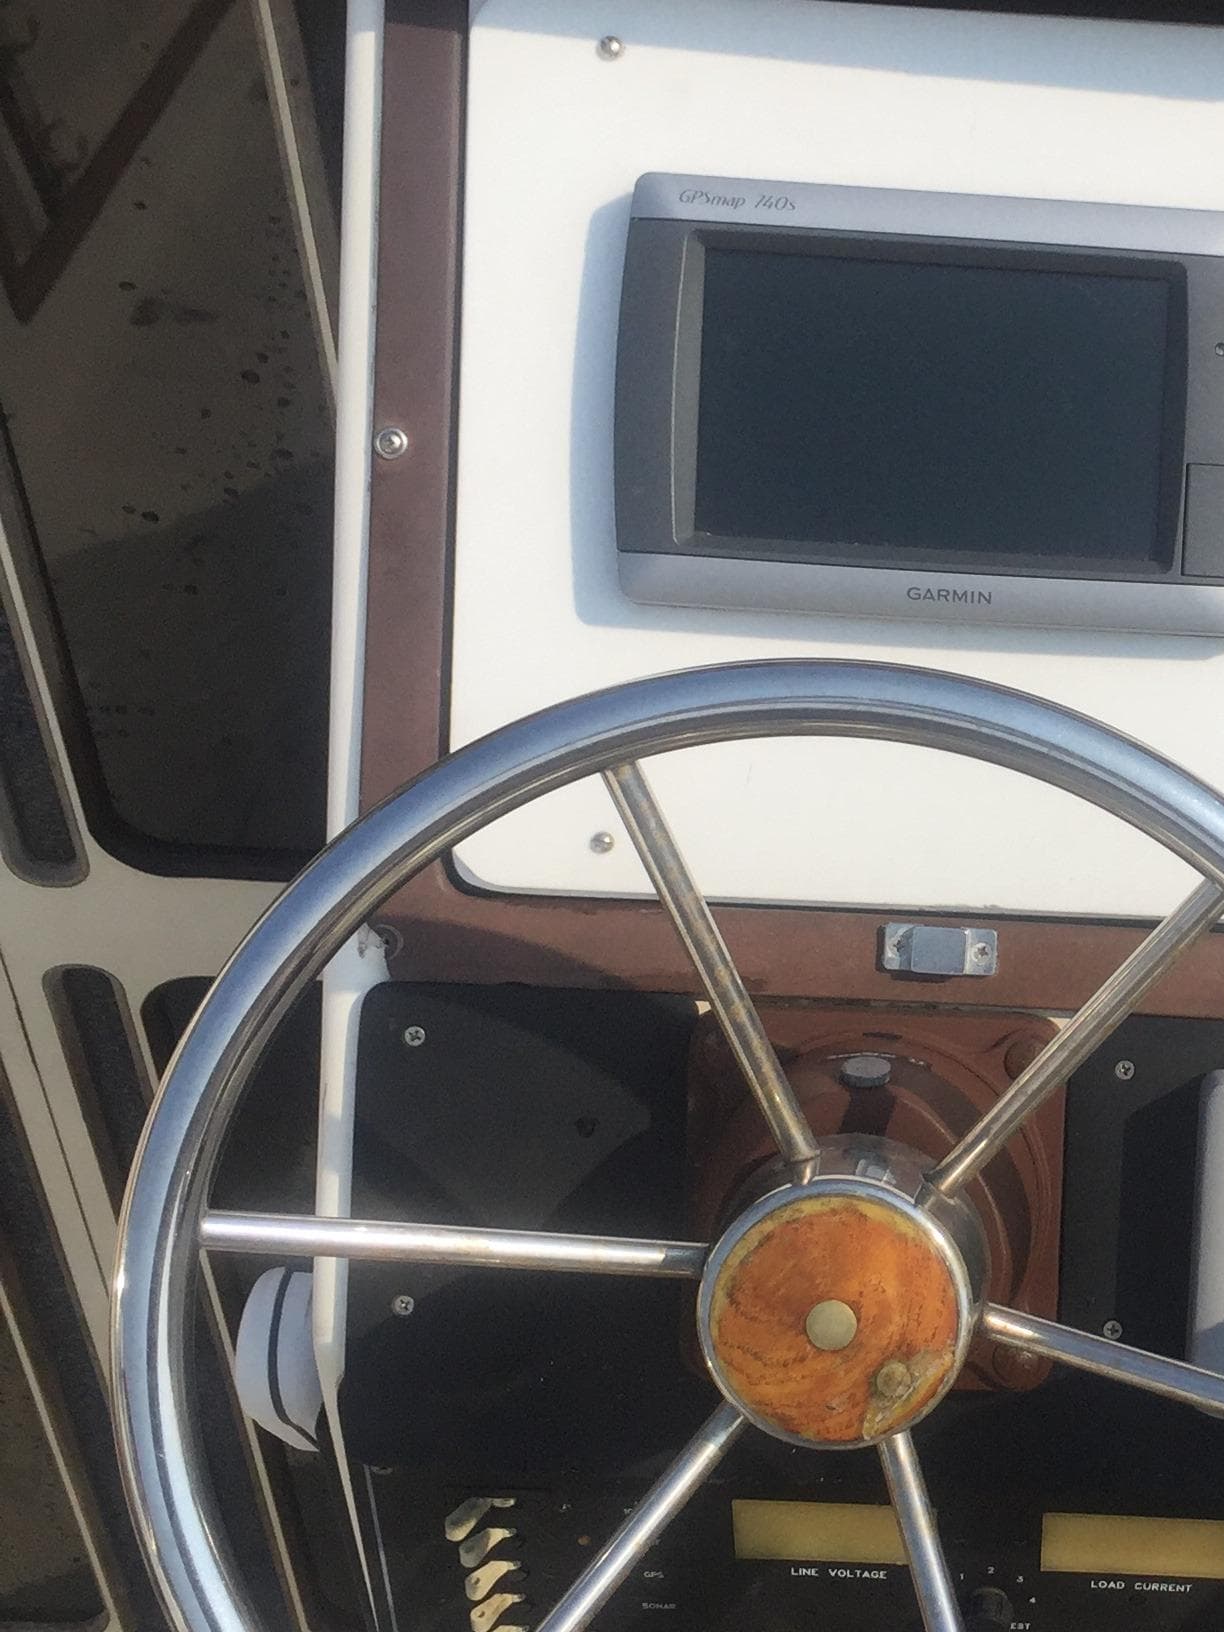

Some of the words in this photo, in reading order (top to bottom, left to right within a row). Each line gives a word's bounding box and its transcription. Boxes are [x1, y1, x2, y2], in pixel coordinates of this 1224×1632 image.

[679, 189, 746, 209] GPSmap
[906, 586, 993, 605] GARMIN
[643, 1570, 665, 1579] GPS
[790, 1567, 819, 1577] LINE
[828, 1568, 888, 1580] VOLTAGE
[1090, 1580, 1126, 1590] LOAD
[1134, 1581, 1193, 1593] CURRENT
[641, 1602, 677, 1610] SONAR
